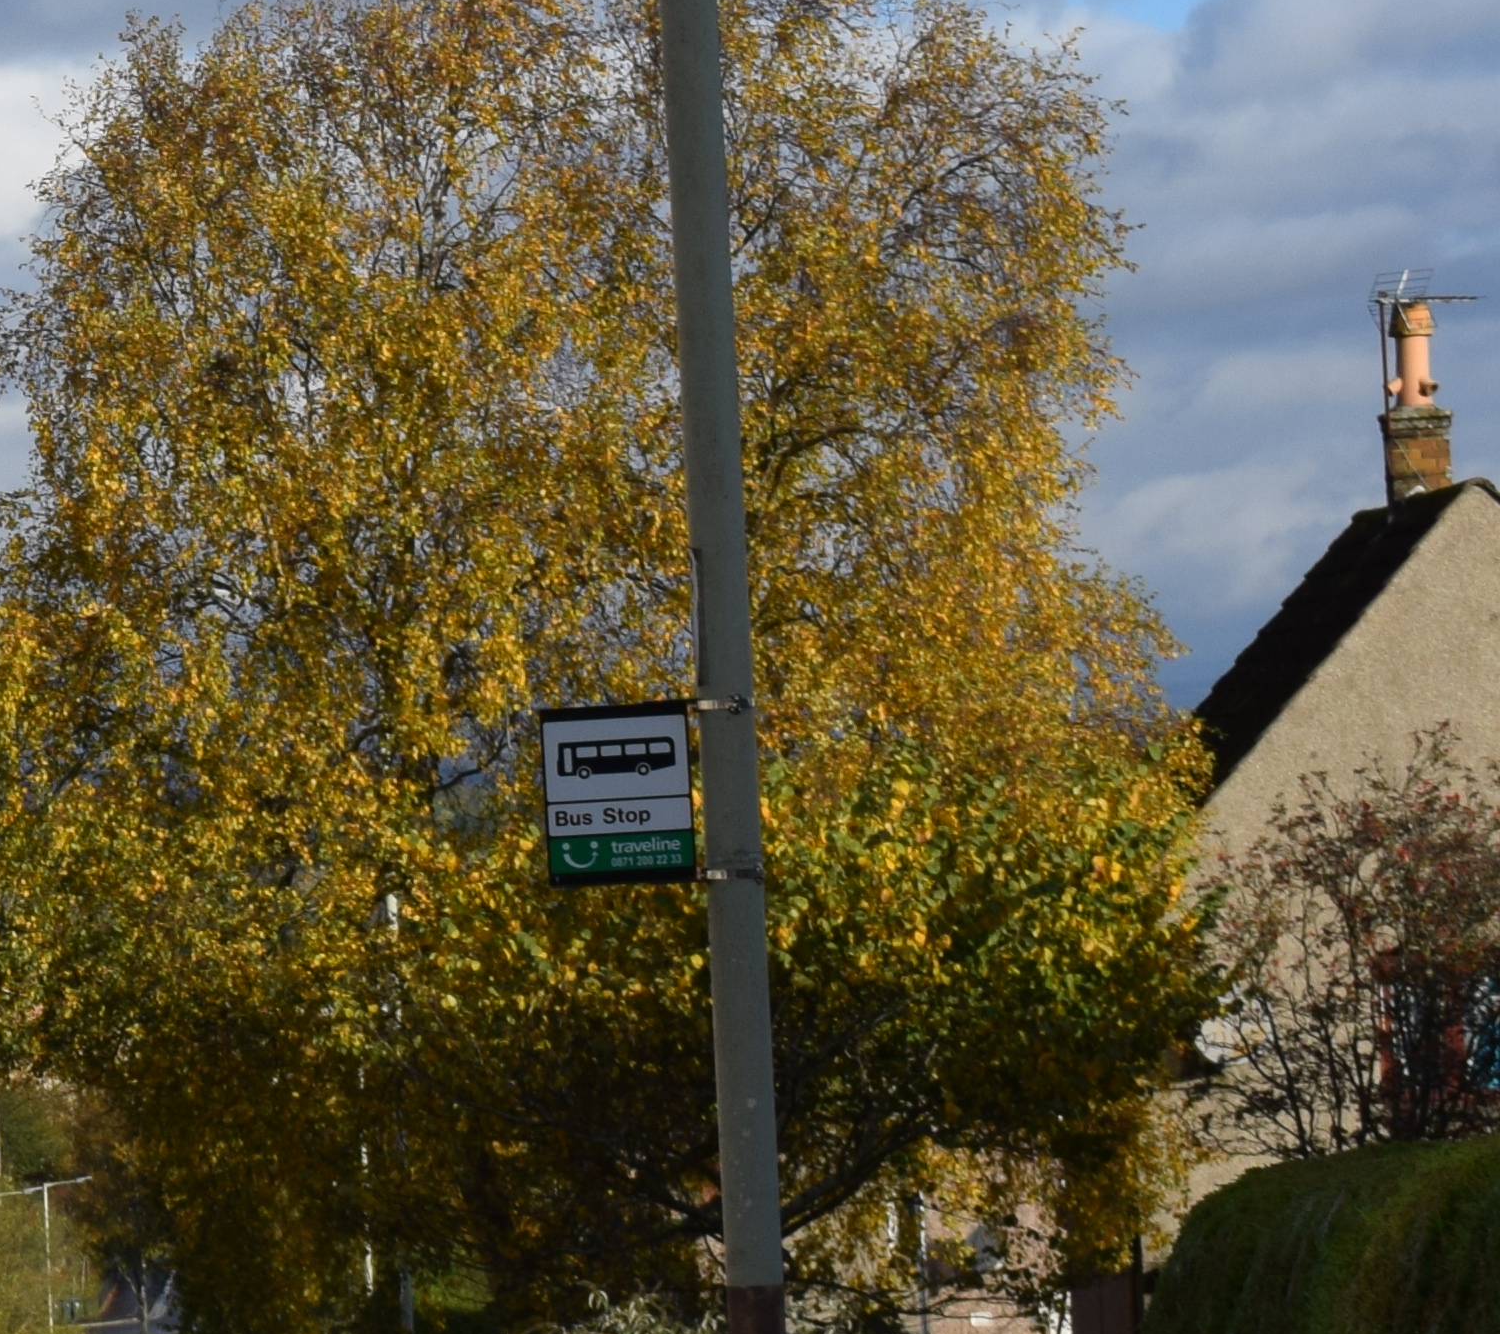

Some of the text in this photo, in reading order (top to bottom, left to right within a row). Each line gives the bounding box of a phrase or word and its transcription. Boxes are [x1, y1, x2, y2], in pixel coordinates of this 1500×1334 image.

[555, 807, 651, 826] Bus Stop
[611, 837, 681, 854] traveline
[611, 854, 682, 867] 0871 200 22 33
